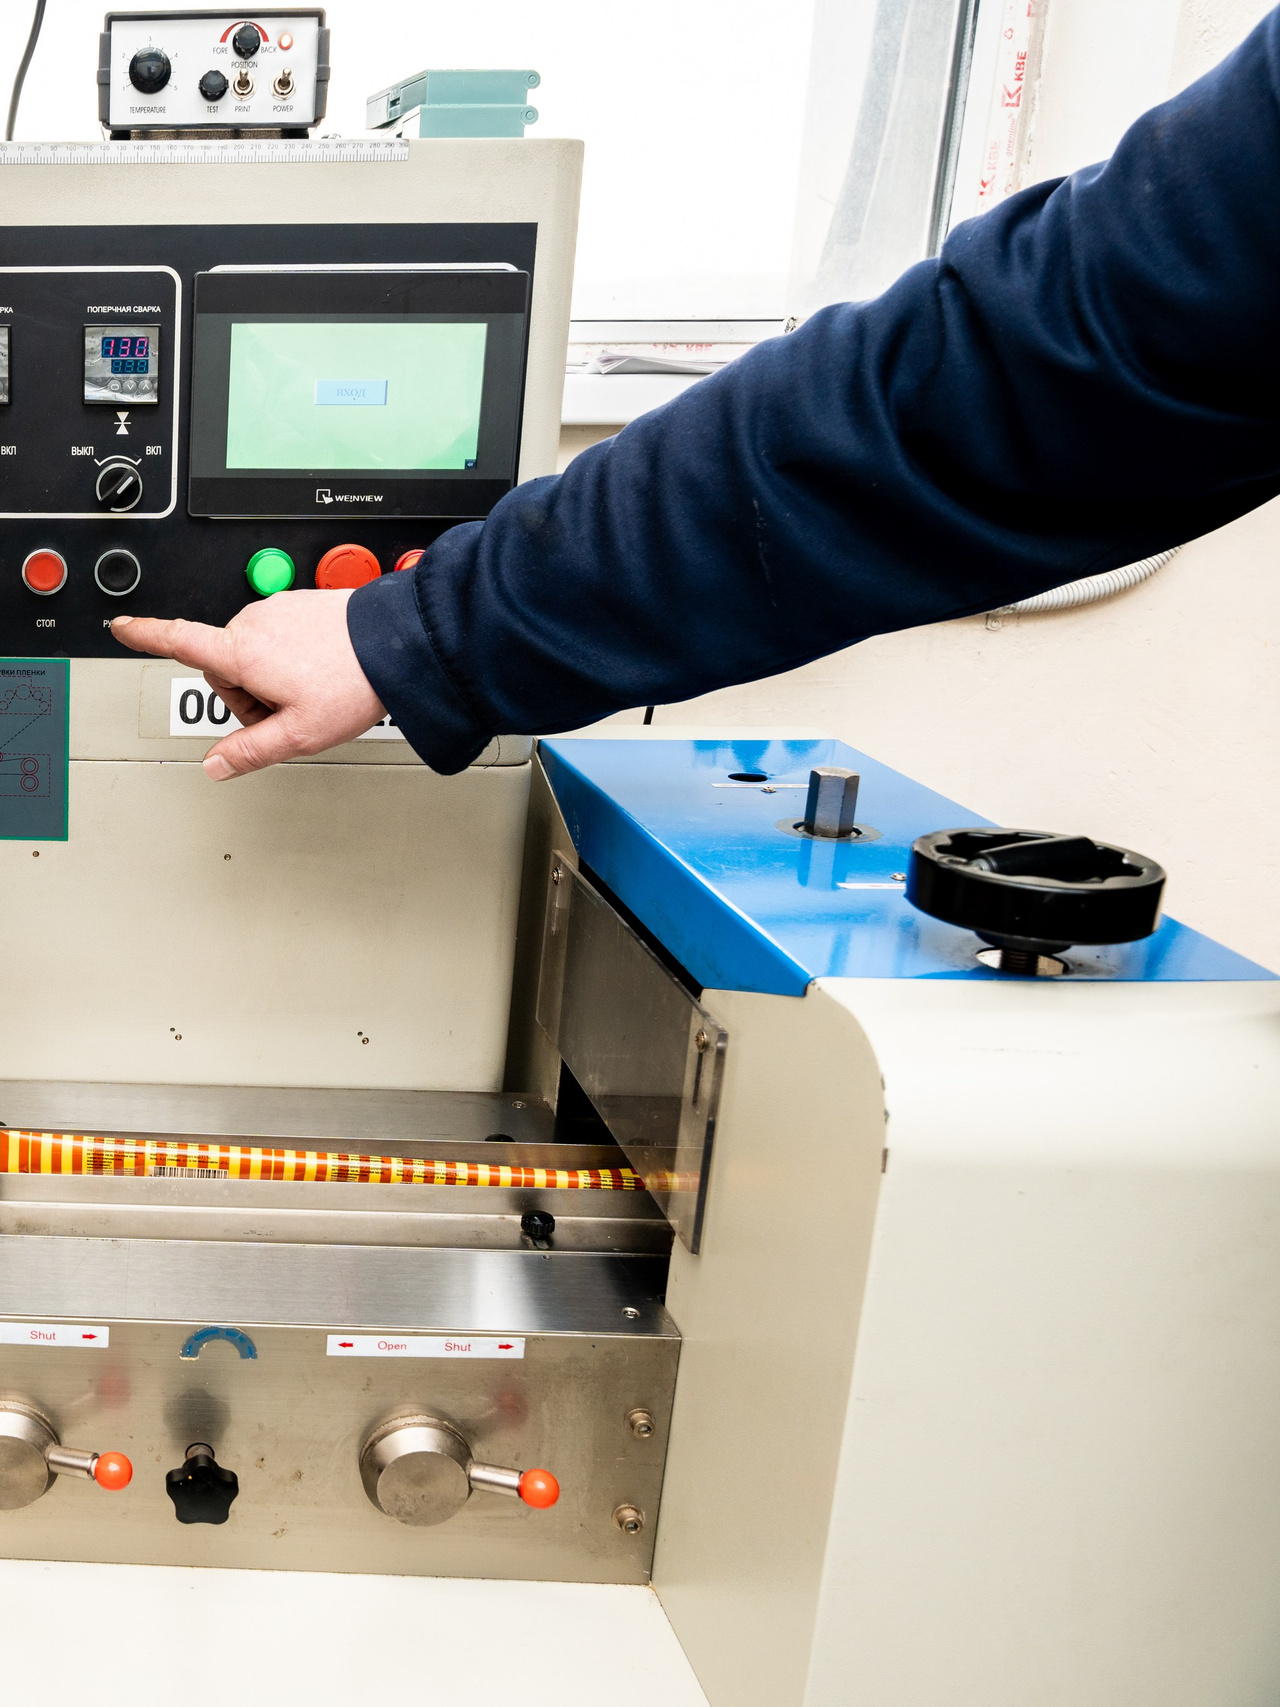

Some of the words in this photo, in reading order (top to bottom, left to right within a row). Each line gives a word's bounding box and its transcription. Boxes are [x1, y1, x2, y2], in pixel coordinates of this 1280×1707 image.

[1014, 51, 1028, 82] KBE
[206, 106, 219, 114] TEST
[110, 338, 148, 357] 130
[336, 388, 366, 399] ВХОД
[1, 446, 16, 455] ВКЛ
[72, 446, 94, 456] ВЫКЛ
[146, 446, 162, 455] ВКЛ
[36, 619, 55, 628] СТОП
[30, 1330, 56, 1341] Shut
[378, 1341, 407, 1352] Open
[444, 1342, 471, 1352] Shut
